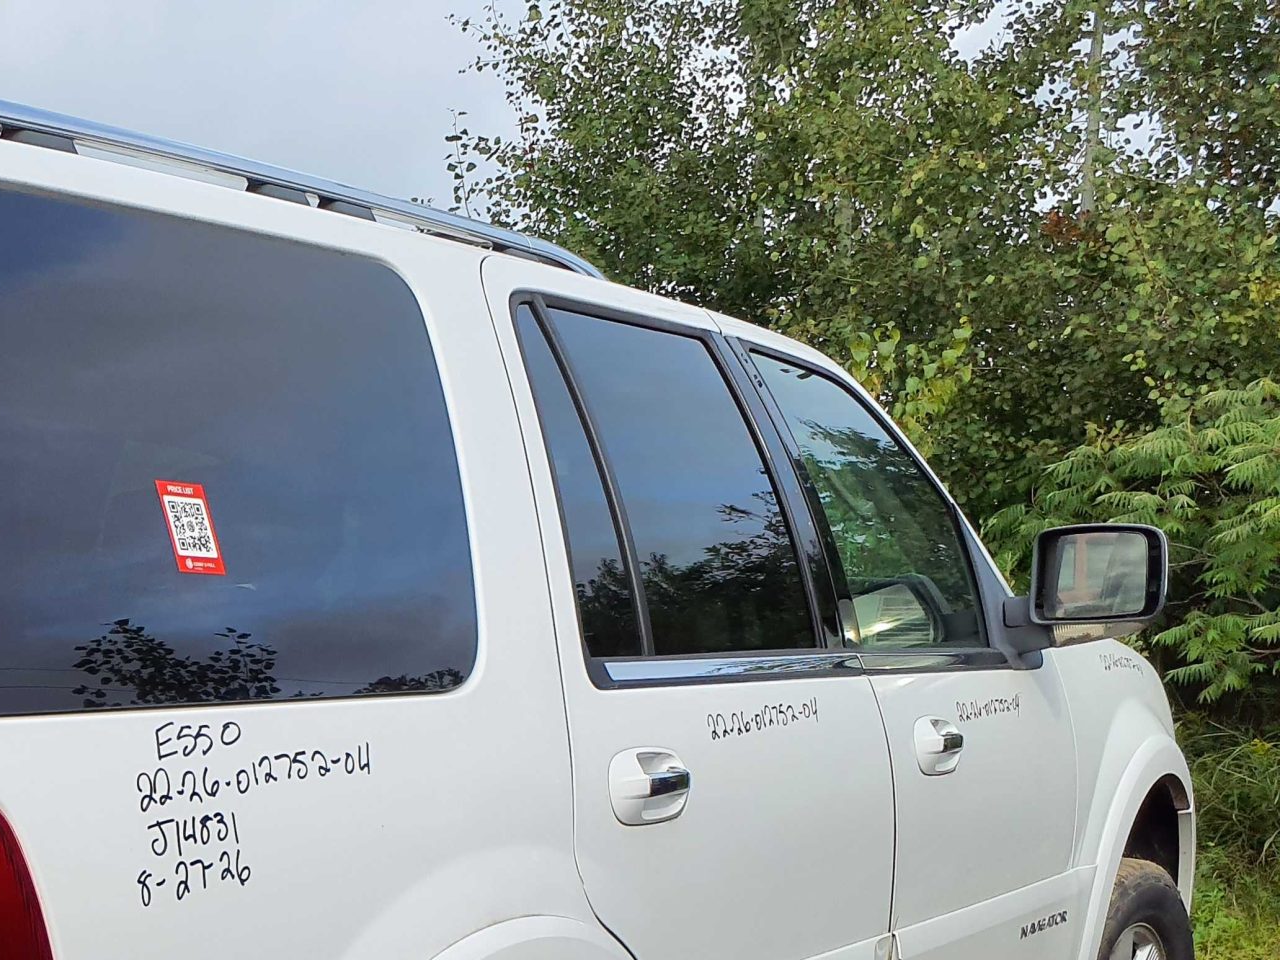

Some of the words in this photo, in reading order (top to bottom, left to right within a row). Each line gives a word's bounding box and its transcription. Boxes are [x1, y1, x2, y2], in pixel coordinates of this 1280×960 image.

[155, 721, 241, 761] E550
[147, 812, 239, 856] J14831
[1019, 910, 1068, 940] NAVIGATOR
